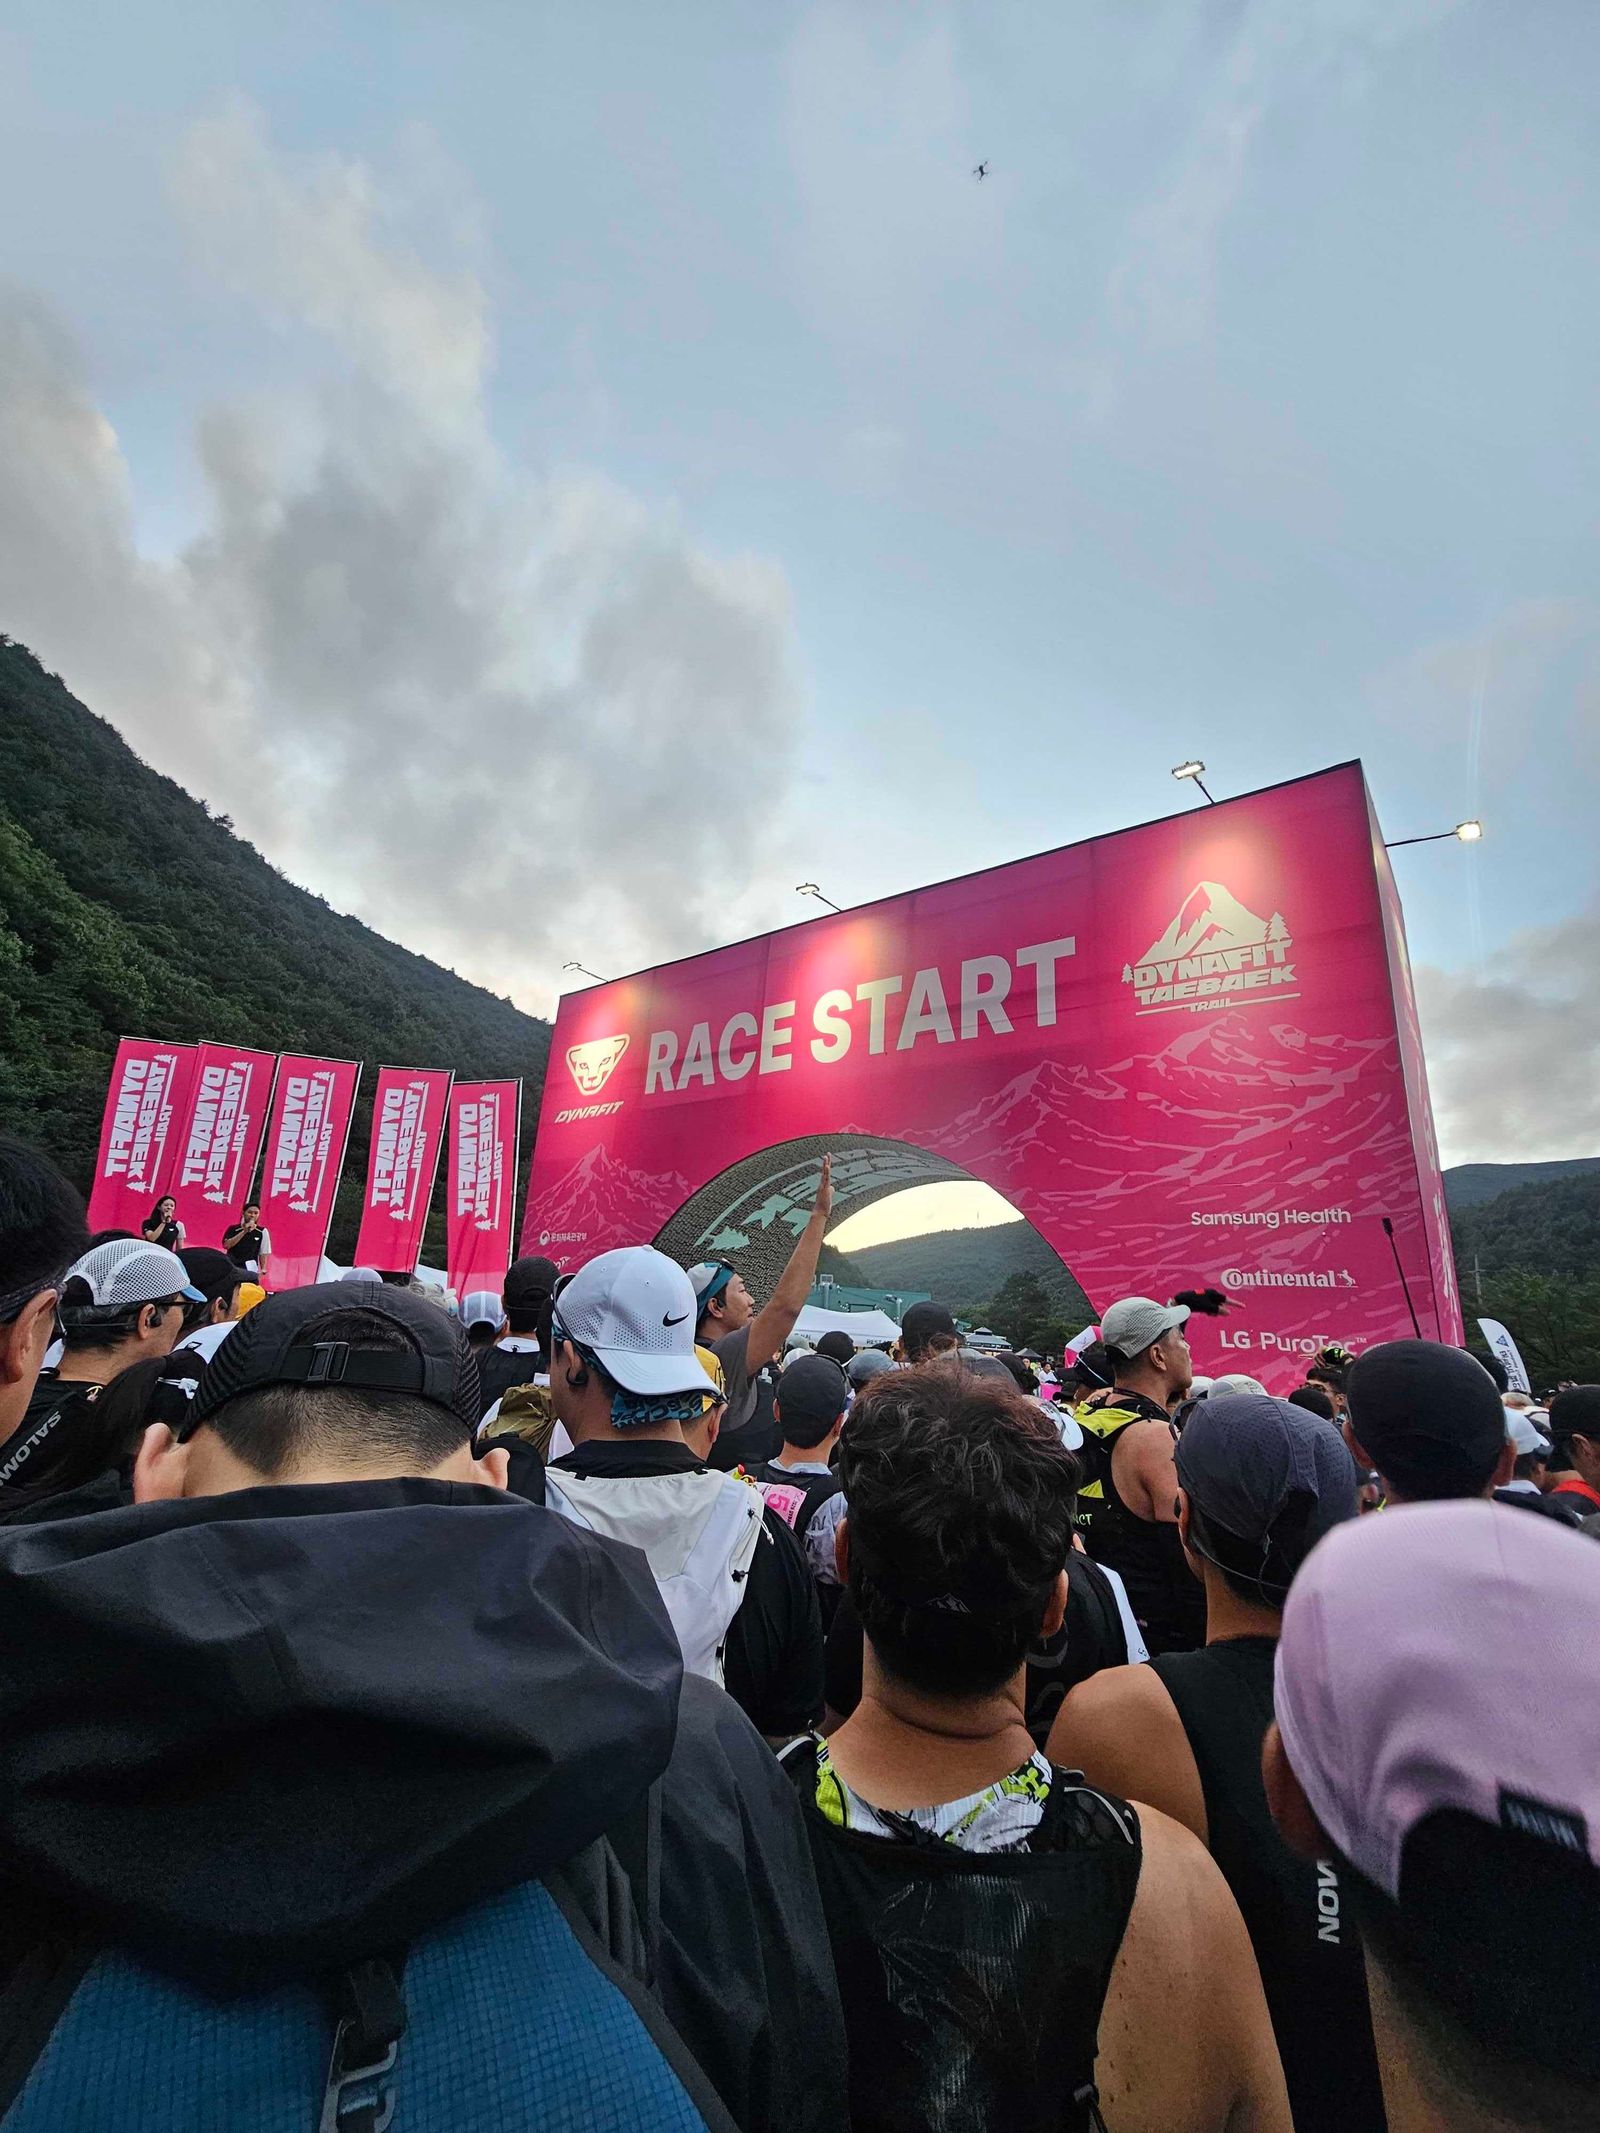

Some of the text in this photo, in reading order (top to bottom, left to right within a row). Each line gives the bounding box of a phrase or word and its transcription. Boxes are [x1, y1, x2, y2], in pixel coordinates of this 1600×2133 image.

[1133, 939, 1293, 989] DYNAFIT
[1134, 964, 1298, 1006] TAEBAEK
[644, 936, 1076, 1096] RACE START
[1187, 998, 1232, 1013] TRAIL
[554, 1100, 624, 1124] DYNAFIT
[1190, 1207, 1352, 1229] Samsung Health
[1220, 1268, 1338, 1290] Continental
[1220, 1329, 1251, 1350] LG
[0, 1411, 61, 1487] SALOM
